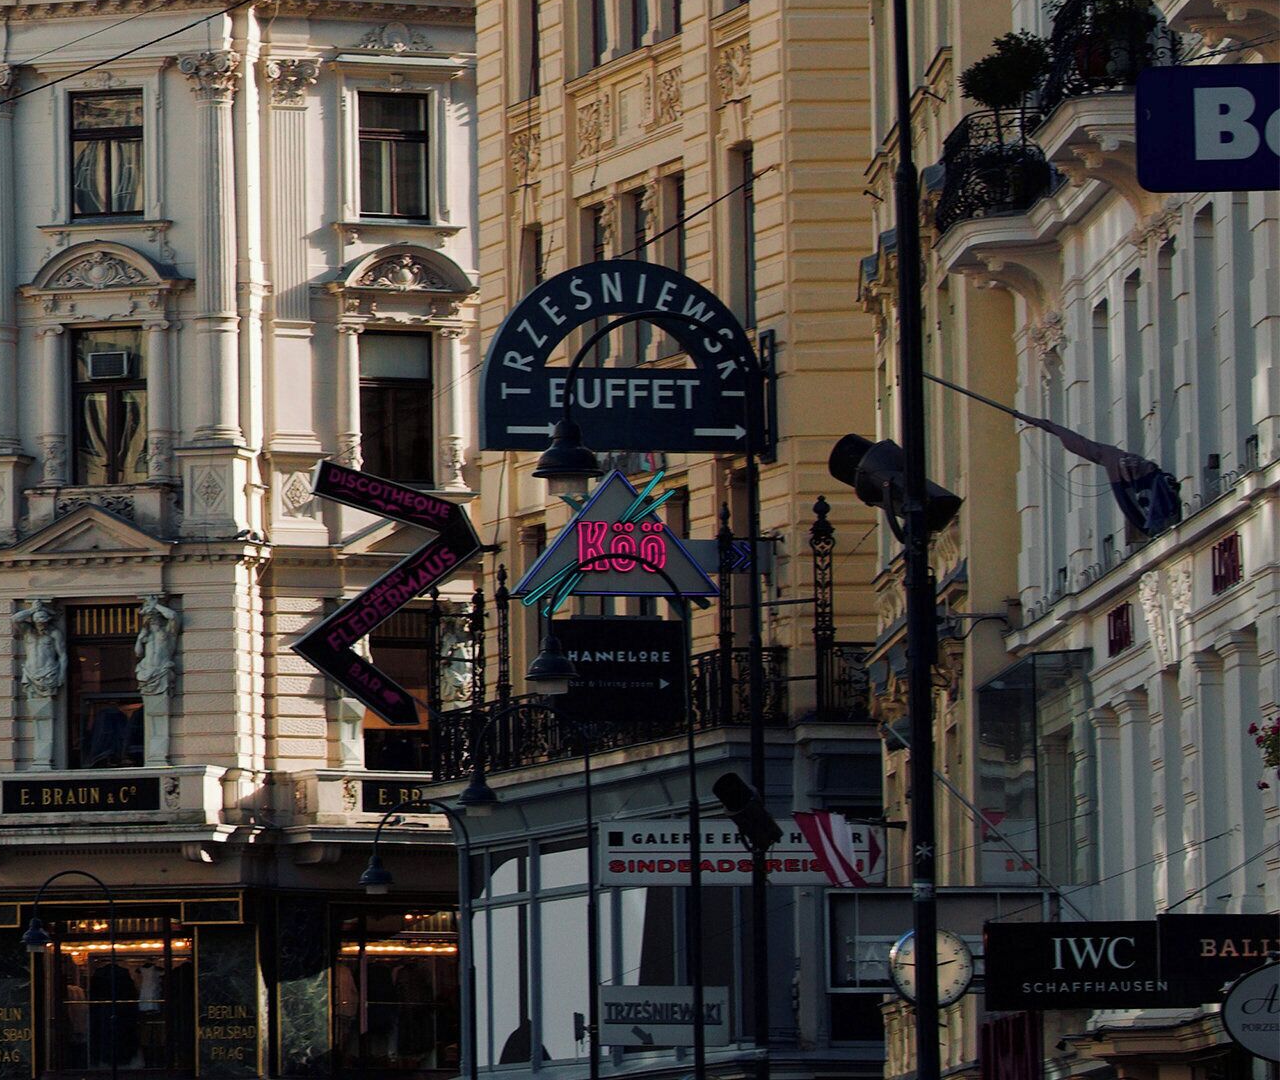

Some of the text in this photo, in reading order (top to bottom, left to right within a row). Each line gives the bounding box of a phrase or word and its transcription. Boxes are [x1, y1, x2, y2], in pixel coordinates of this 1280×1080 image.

[1193, 86, 1280, 161] B
[549, 377, 701, 410] BUFFET
[329, 466, 451, 519] DISCOTHEQUE
[360, 568, 406, 607] CABARET
[327, 546, 458, 653] FLEDERMAUS
[567, 650, 671, 663] HANNELORE
[346, 664, 382, 693] BAR
[20, 788, 36, 806] E.
[41, 786, 100, 806] BRAUN
[632, 833, 714, 845] GALERE
[1052, 936, 1137, 971] IWC
[1199, 938, 1280, 957] BALL
[1022, 980, 1169, 995] SCHAFFHAUSEN
[207, 1004, 247, 1020] BERLIN
[604, 1000, 721, 1021] TRZEŚNIEWKI
[198, 1024, 256, 1040] KARLSBAD
[1241, 1023, 1280, 1032] PORZEL
[210, 1045, 245, 1061] PRAG
